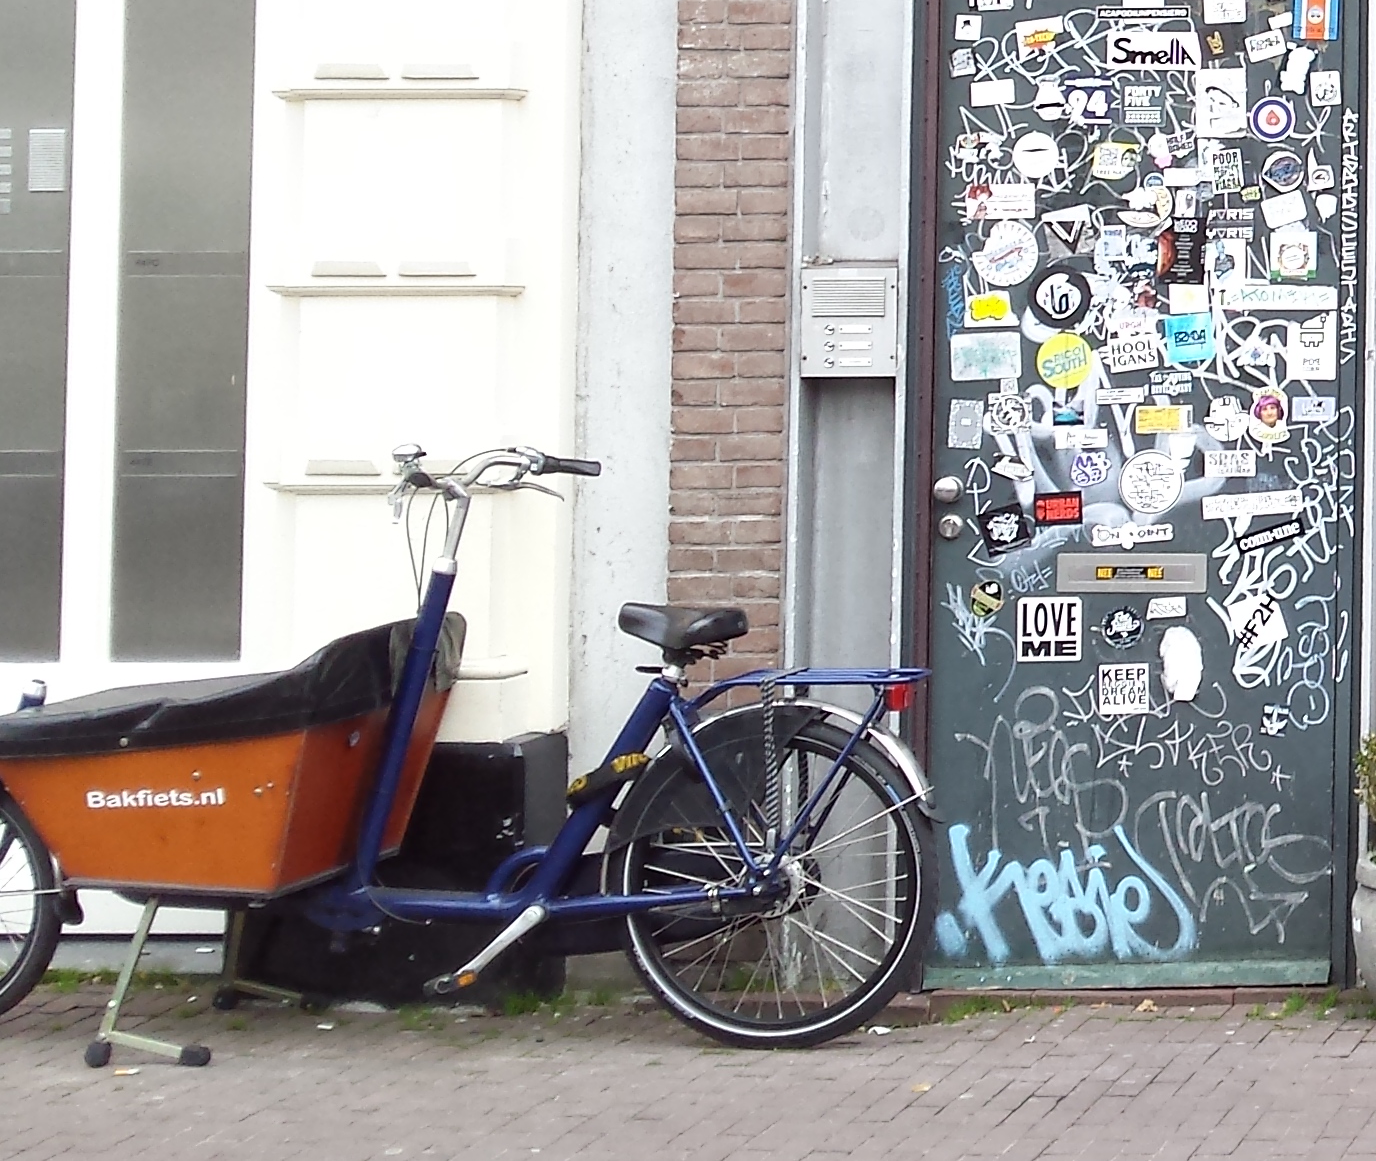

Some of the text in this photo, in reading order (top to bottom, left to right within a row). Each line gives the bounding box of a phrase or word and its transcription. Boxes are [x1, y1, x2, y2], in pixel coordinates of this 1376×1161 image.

[1112, 339, 1153, 355] HOOL
[1112, 351, 1155, 367] IGANS
[1022, 603, 1077, 637] LOVE
[1240, 594, 1275, 648] #F2H
[1021, 641, 1077, 657] ME
[1102, 668, 1146, 681] KEEP
[1102, 694, 1146, 706] ALIVE
[86, 788, 226, 809] Bakfiets.nl
